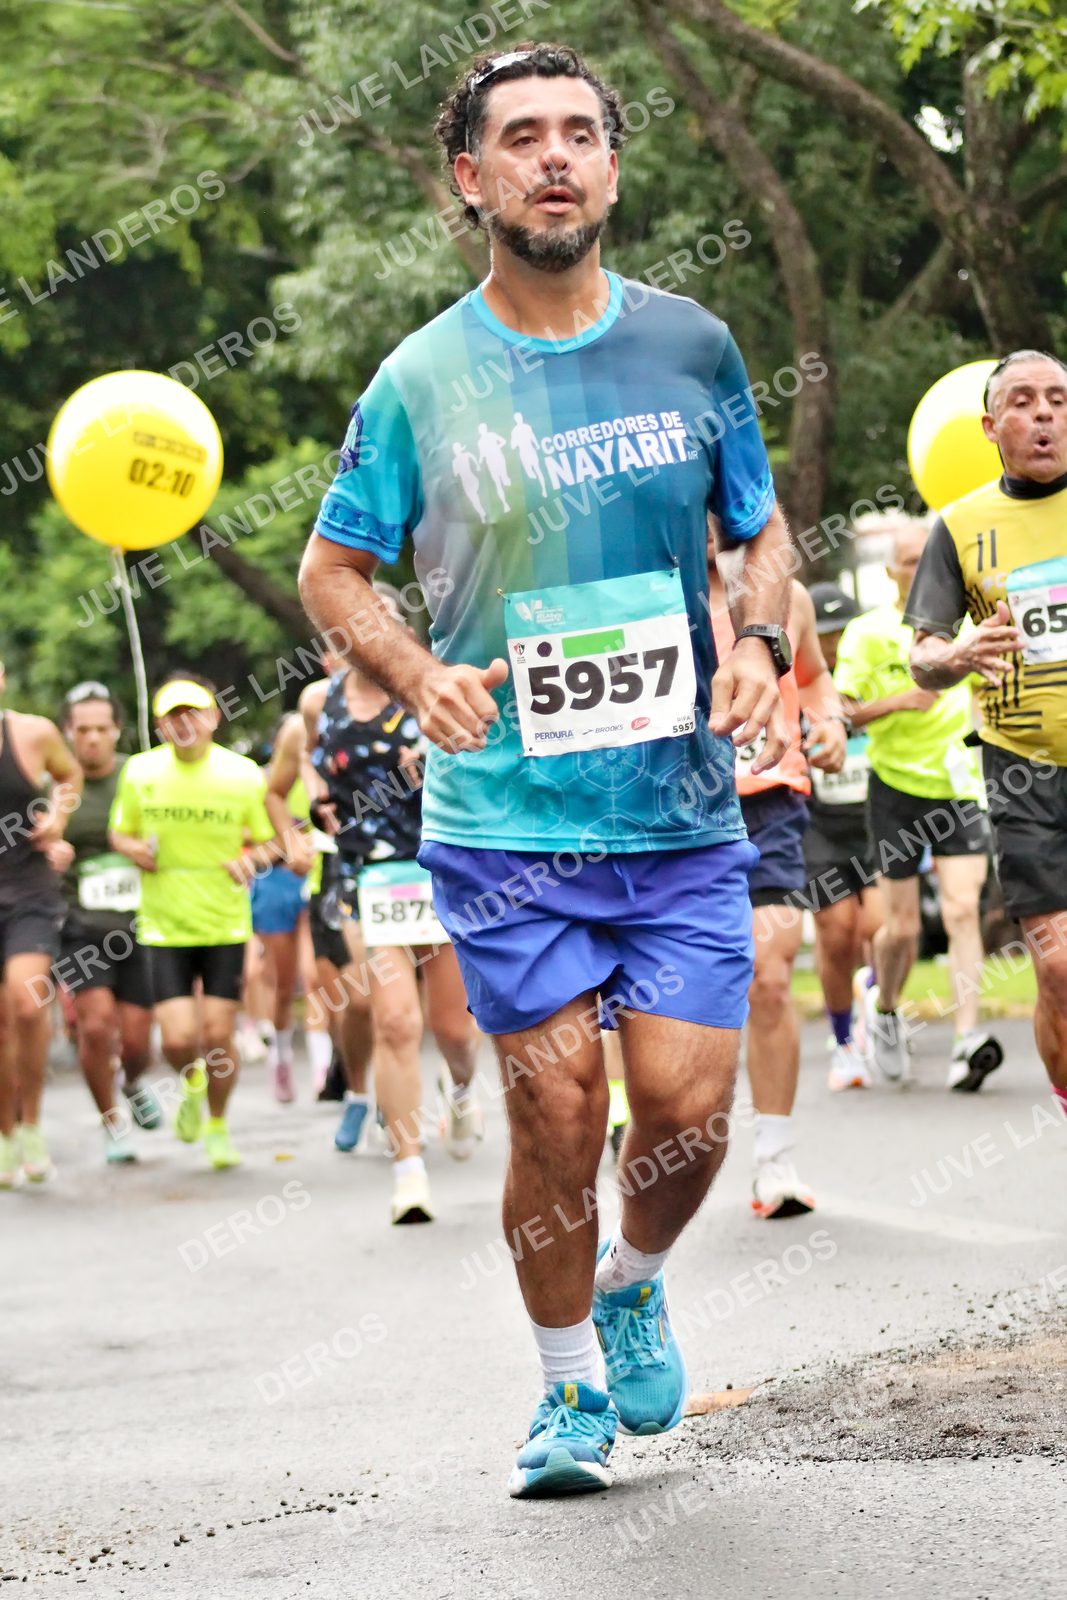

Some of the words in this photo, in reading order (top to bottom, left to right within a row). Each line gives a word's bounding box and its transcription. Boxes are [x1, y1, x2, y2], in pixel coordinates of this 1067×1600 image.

[541, 414, 660, 454] CORREDORES
[659, 411, 684, 429] DE
[129, 457, 197, 498] 02:10
[544, 428, 688, 490] NAYARIT
[528, 645, 679, 716] 5957
[535, 729, 575, 741] PERDURA
[595, 724, 624, 734] BROOKS
[672, 721, 694, 734] 5957
